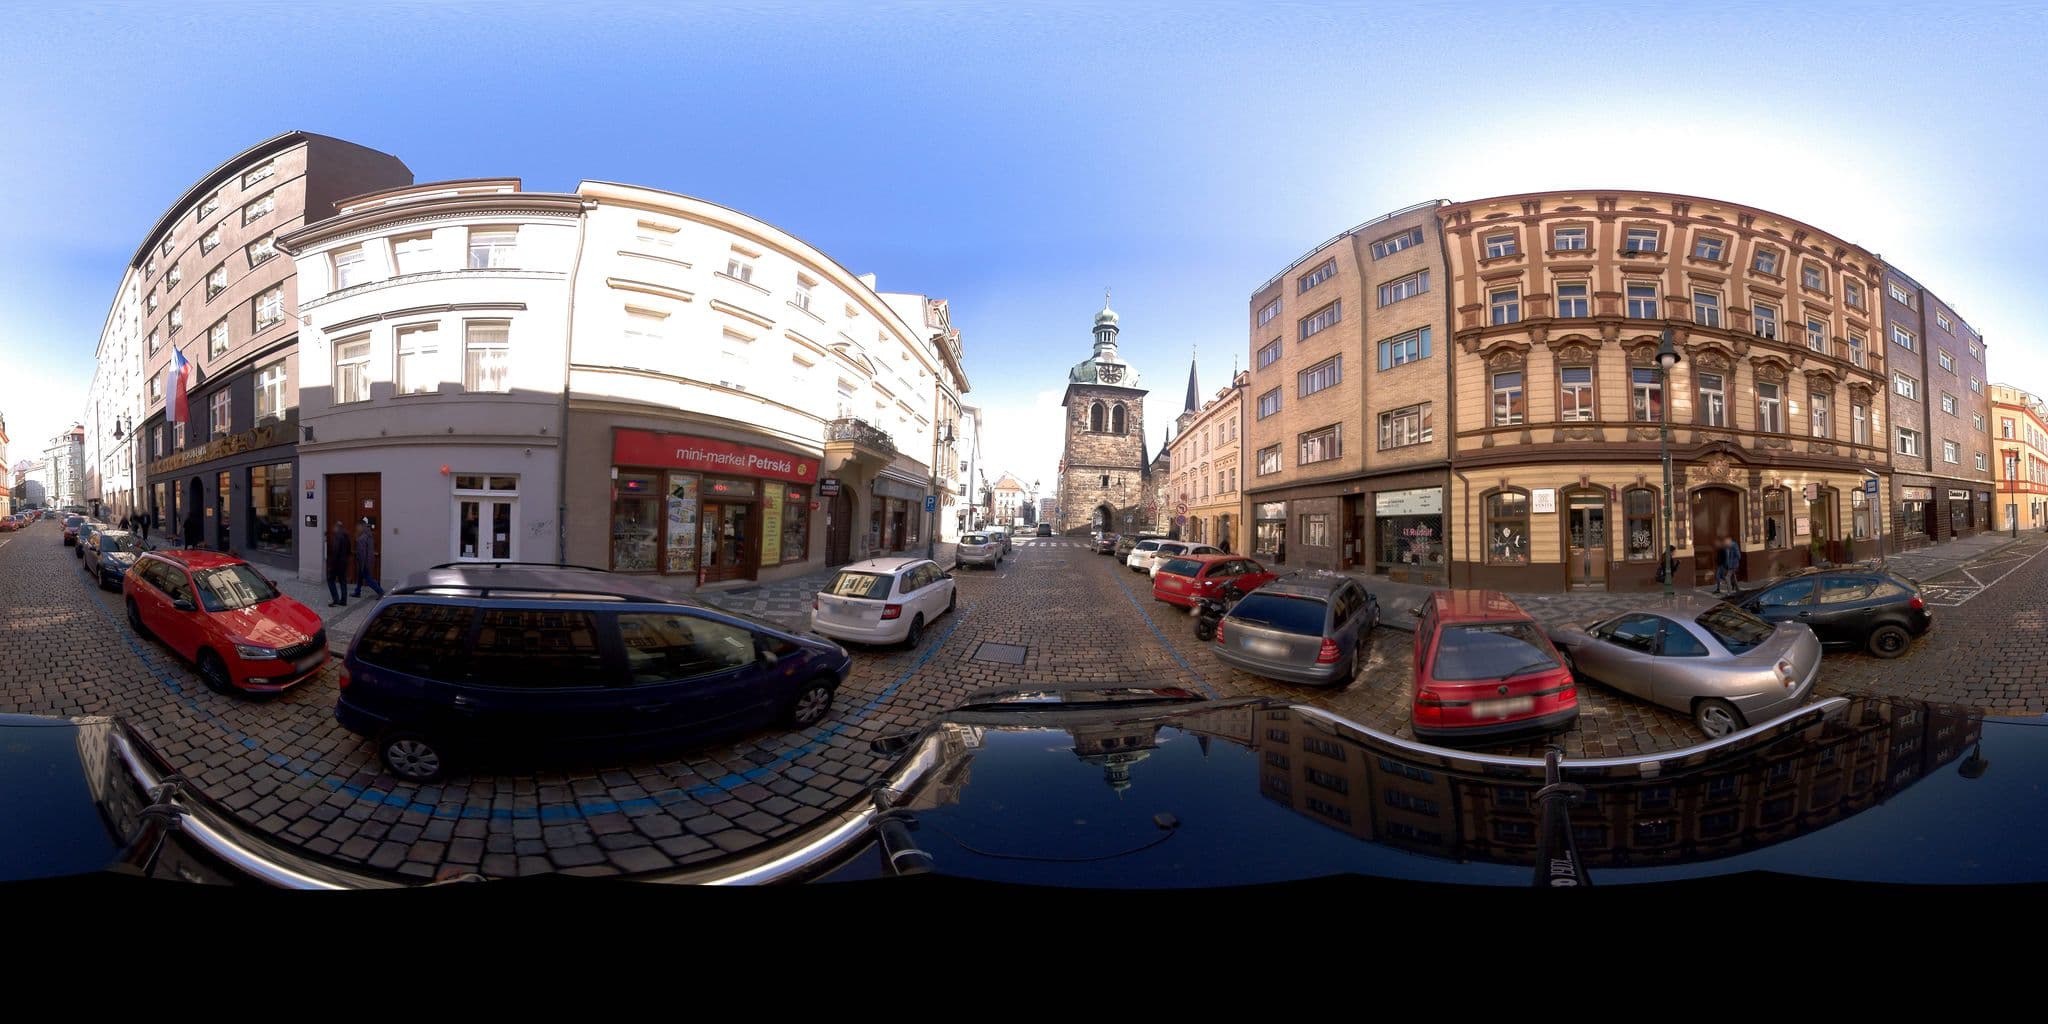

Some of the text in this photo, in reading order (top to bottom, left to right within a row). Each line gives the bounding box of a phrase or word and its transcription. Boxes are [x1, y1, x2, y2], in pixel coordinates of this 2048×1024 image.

[676, 448, 746, 466] mini-market
[747, 455, 791, 473] Petrská
[928, 497, 934, 507] P
